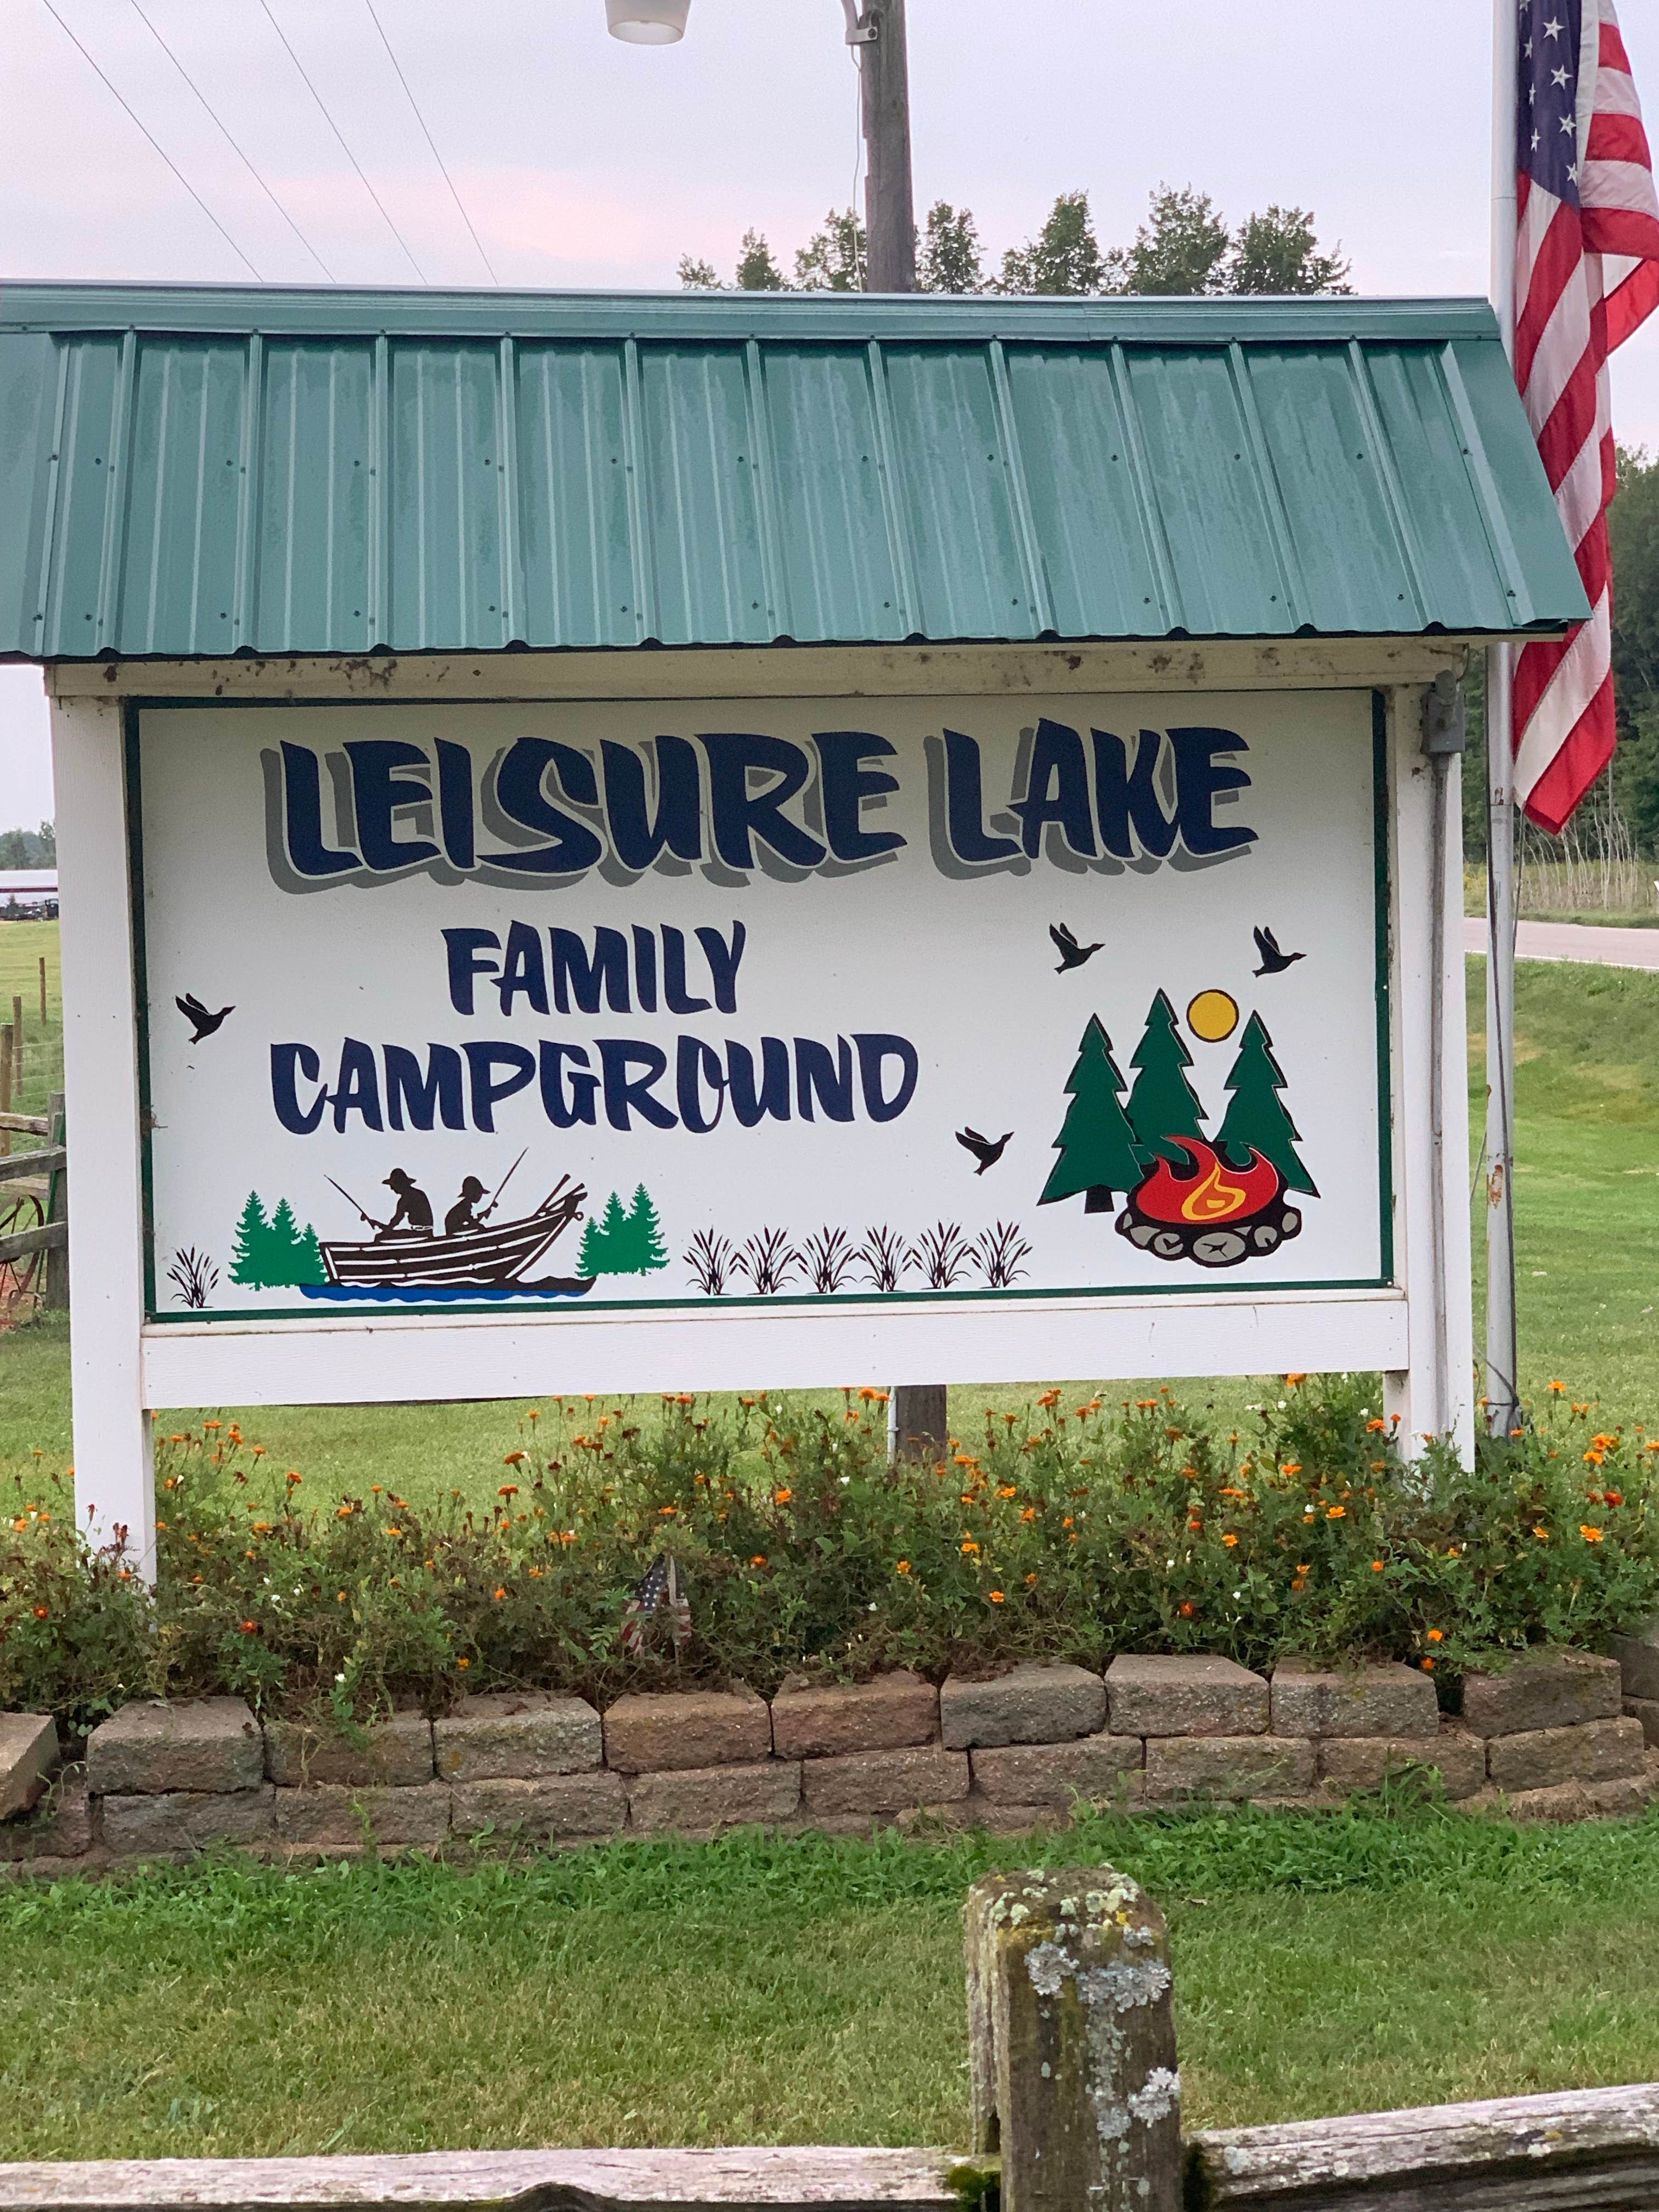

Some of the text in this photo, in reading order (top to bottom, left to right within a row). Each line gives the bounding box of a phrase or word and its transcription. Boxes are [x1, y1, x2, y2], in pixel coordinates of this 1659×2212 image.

[263, 718, 1260, 894] LEISURE LAKE
[441, 920, 746, 1016] FAMILY
[270, 1032, 919, 1135] CAMPGROUND
